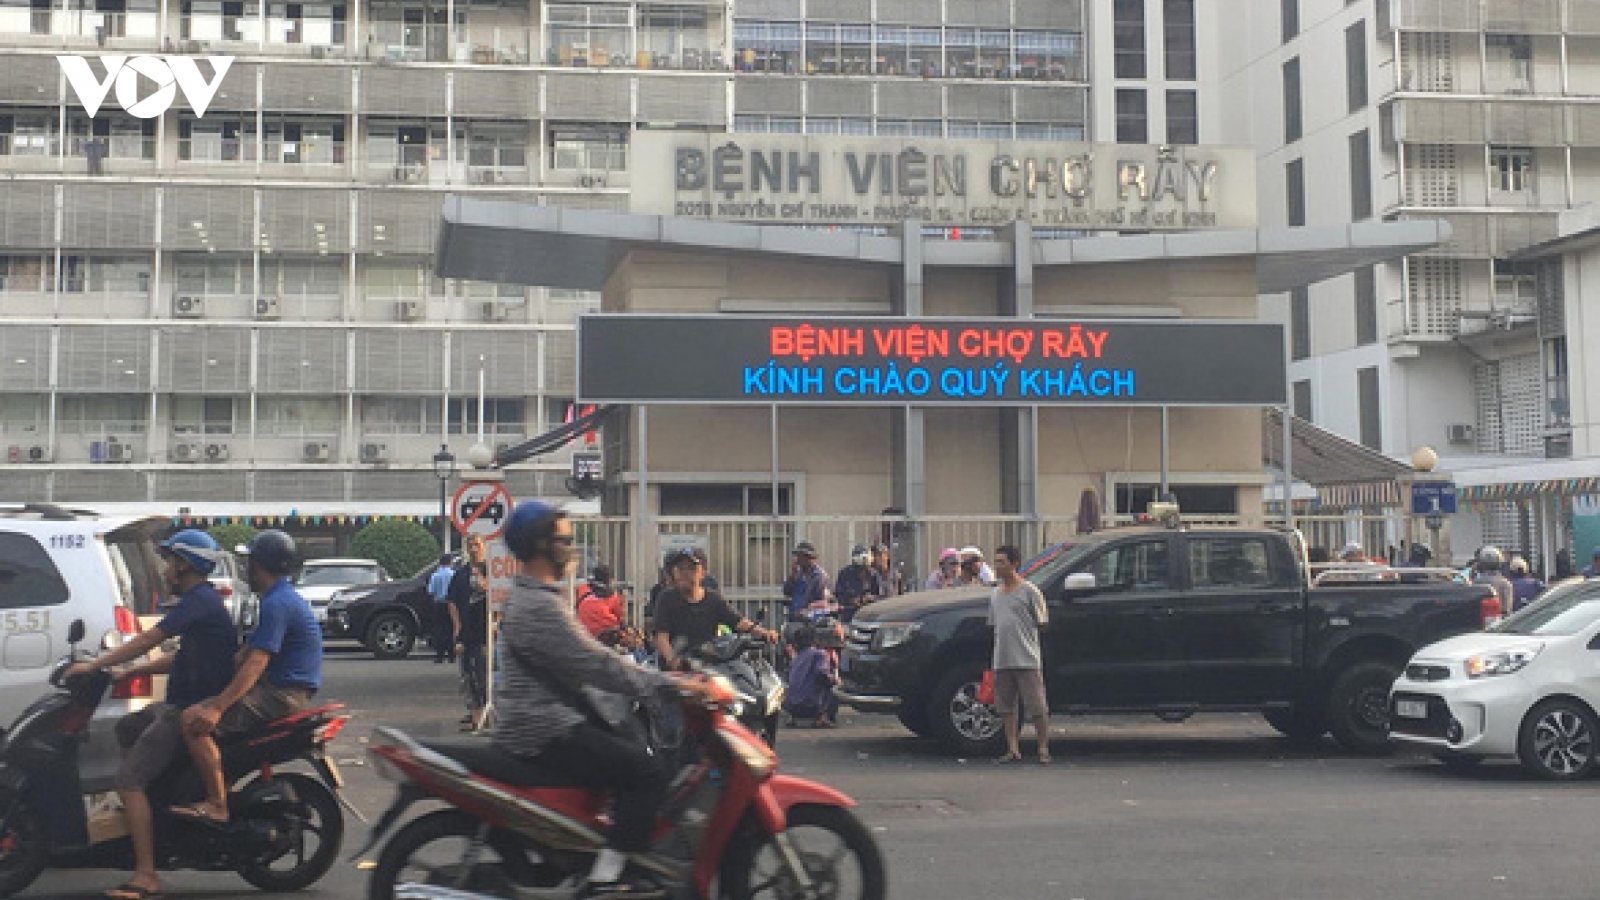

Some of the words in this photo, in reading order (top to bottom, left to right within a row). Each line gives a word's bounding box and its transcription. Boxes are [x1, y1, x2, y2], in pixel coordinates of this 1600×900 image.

[675, 141, 821, 199] BỆNH
[844, 146, 966, 203] VIỆN
[990, 154, 1093, 206] CHỢ
[770, 323, 864, 363] BỆNH
[872, 323, 949, 363] VIỆN
[957, 328, 1034, 363] CHỢ
[743, 359, 824, 395] KÍNH
[833, 359, 931, 396] CHÀO
[940, 361, 1010, 397] QUÝ
[1019, 361, 1135, 397] KHÁCH
